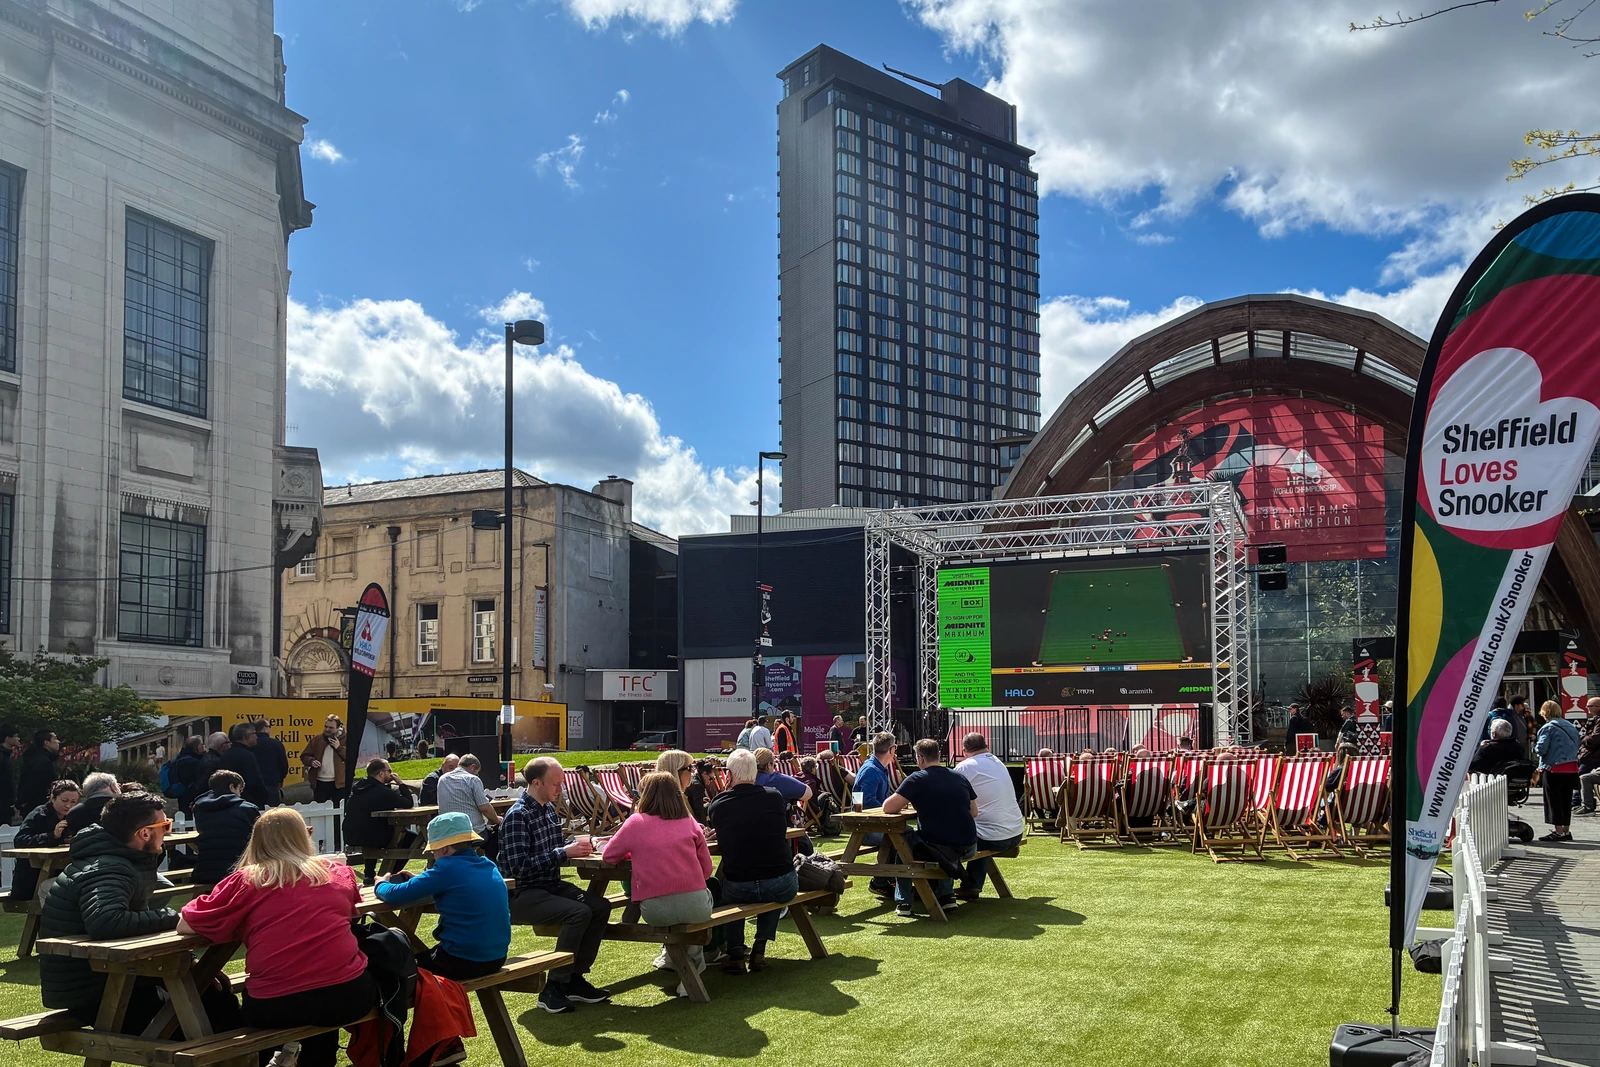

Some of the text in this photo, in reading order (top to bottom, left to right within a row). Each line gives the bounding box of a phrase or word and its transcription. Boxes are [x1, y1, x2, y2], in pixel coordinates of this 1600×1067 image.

[1442, 412, 1577, 454] Sheffield
[1440, 458, 1518, 485] Loves
[1287, 475, 1321, 486] HALO
[1273, 484, 1336, 495] WORLD CHAMPIONSHIP
[1438, 485, 1548, 517] Snooker
[1262, 504, 1349, 518] 32 DREAMS
[1274, 516, 1350, 530] CHAMPION
[619, 676, 652, 691] TFC
[1428, 550, 1534, 818] www.WelcomeToSheffield.co.uk/Snooker
[289, 715, 313, 726] love
[569, 716, 581, 726] TFC
[275, 731, 299, 742] skill
[1408, 828, 1436, 839] Sheffield
